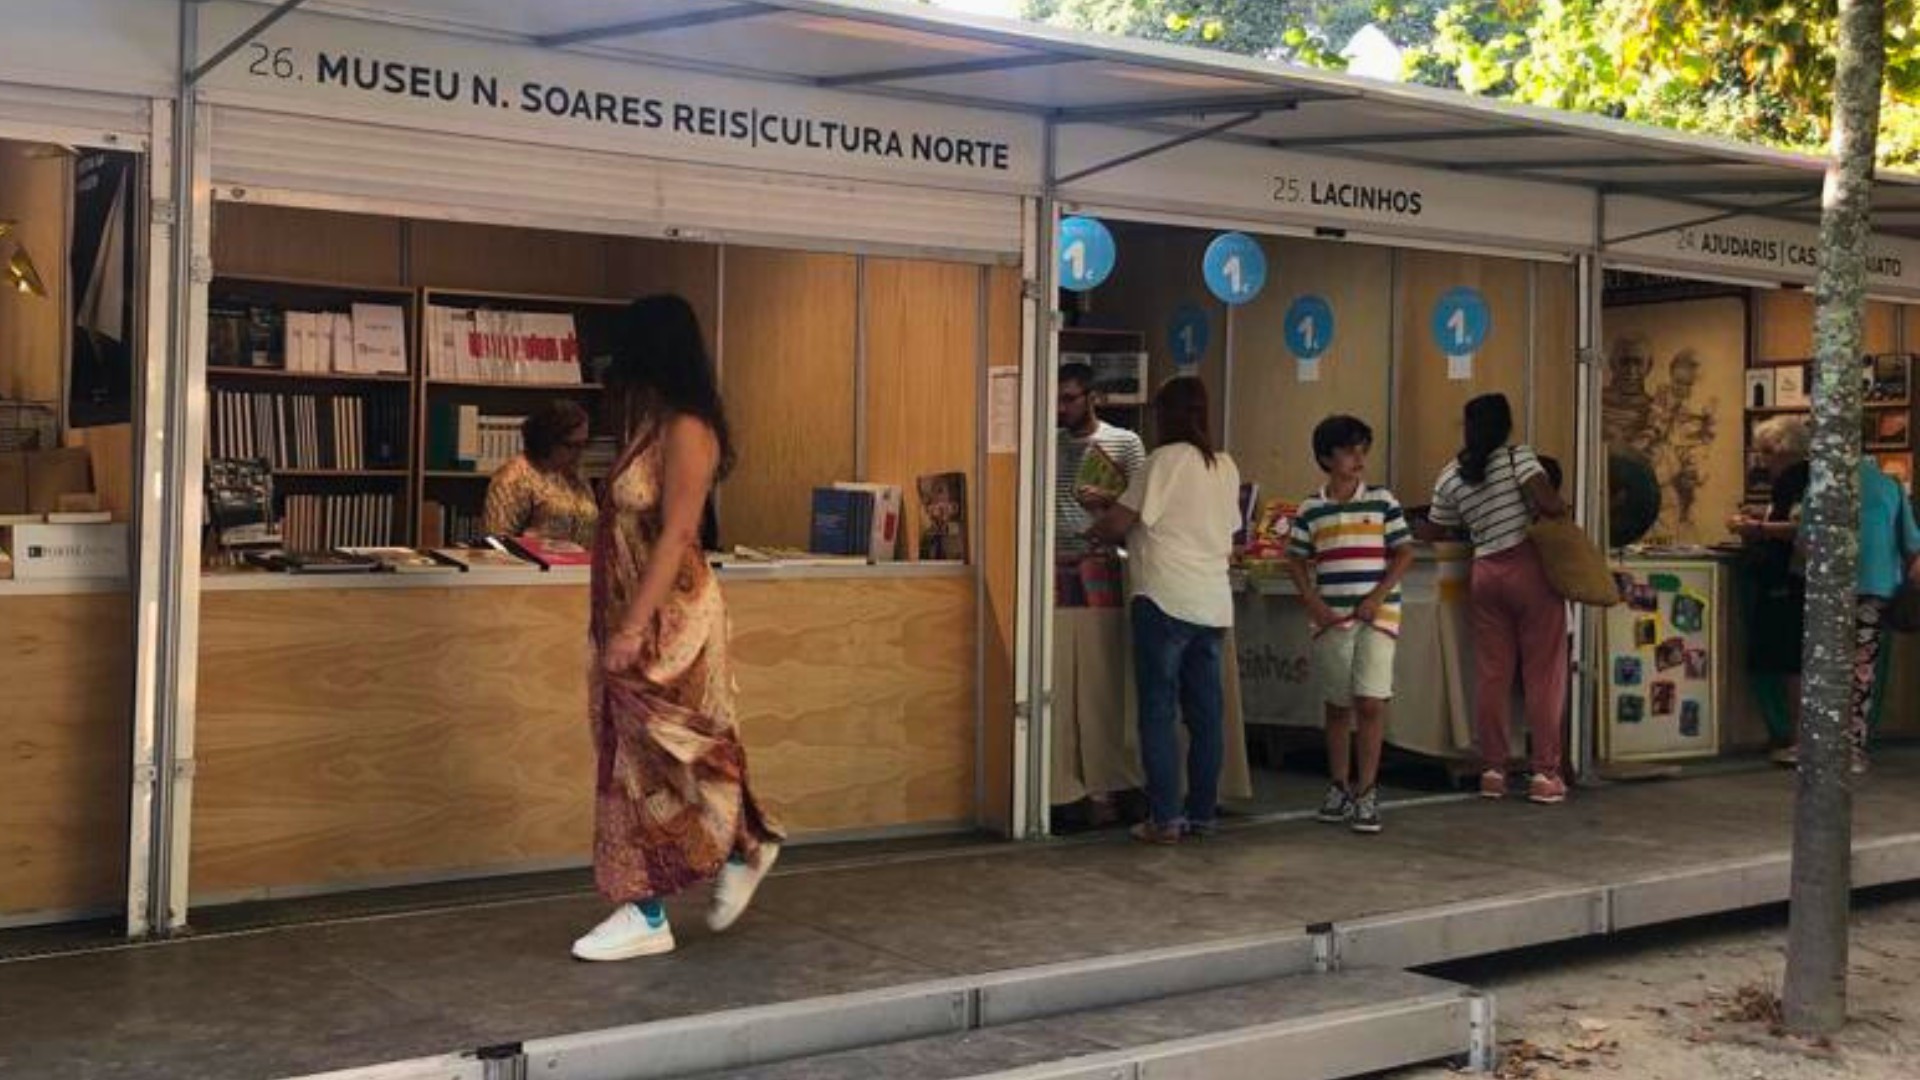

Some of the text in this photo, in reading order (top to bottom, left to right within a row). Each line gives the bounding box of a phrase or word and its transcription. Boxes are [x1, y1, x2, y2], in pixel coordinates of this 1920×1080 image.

[248, 42, 304, 80] 26.
[316, 51, 460, 101] MUSEU
[472, 74, 510, 109] N.
[520, 83, 663, 128] SOARES
[911, 132, 1010, 170] NORTE
[1272, 176, 1422, 215] 25. LACINHOS
[1701, 232, 1777, 262] AJUDARIS
